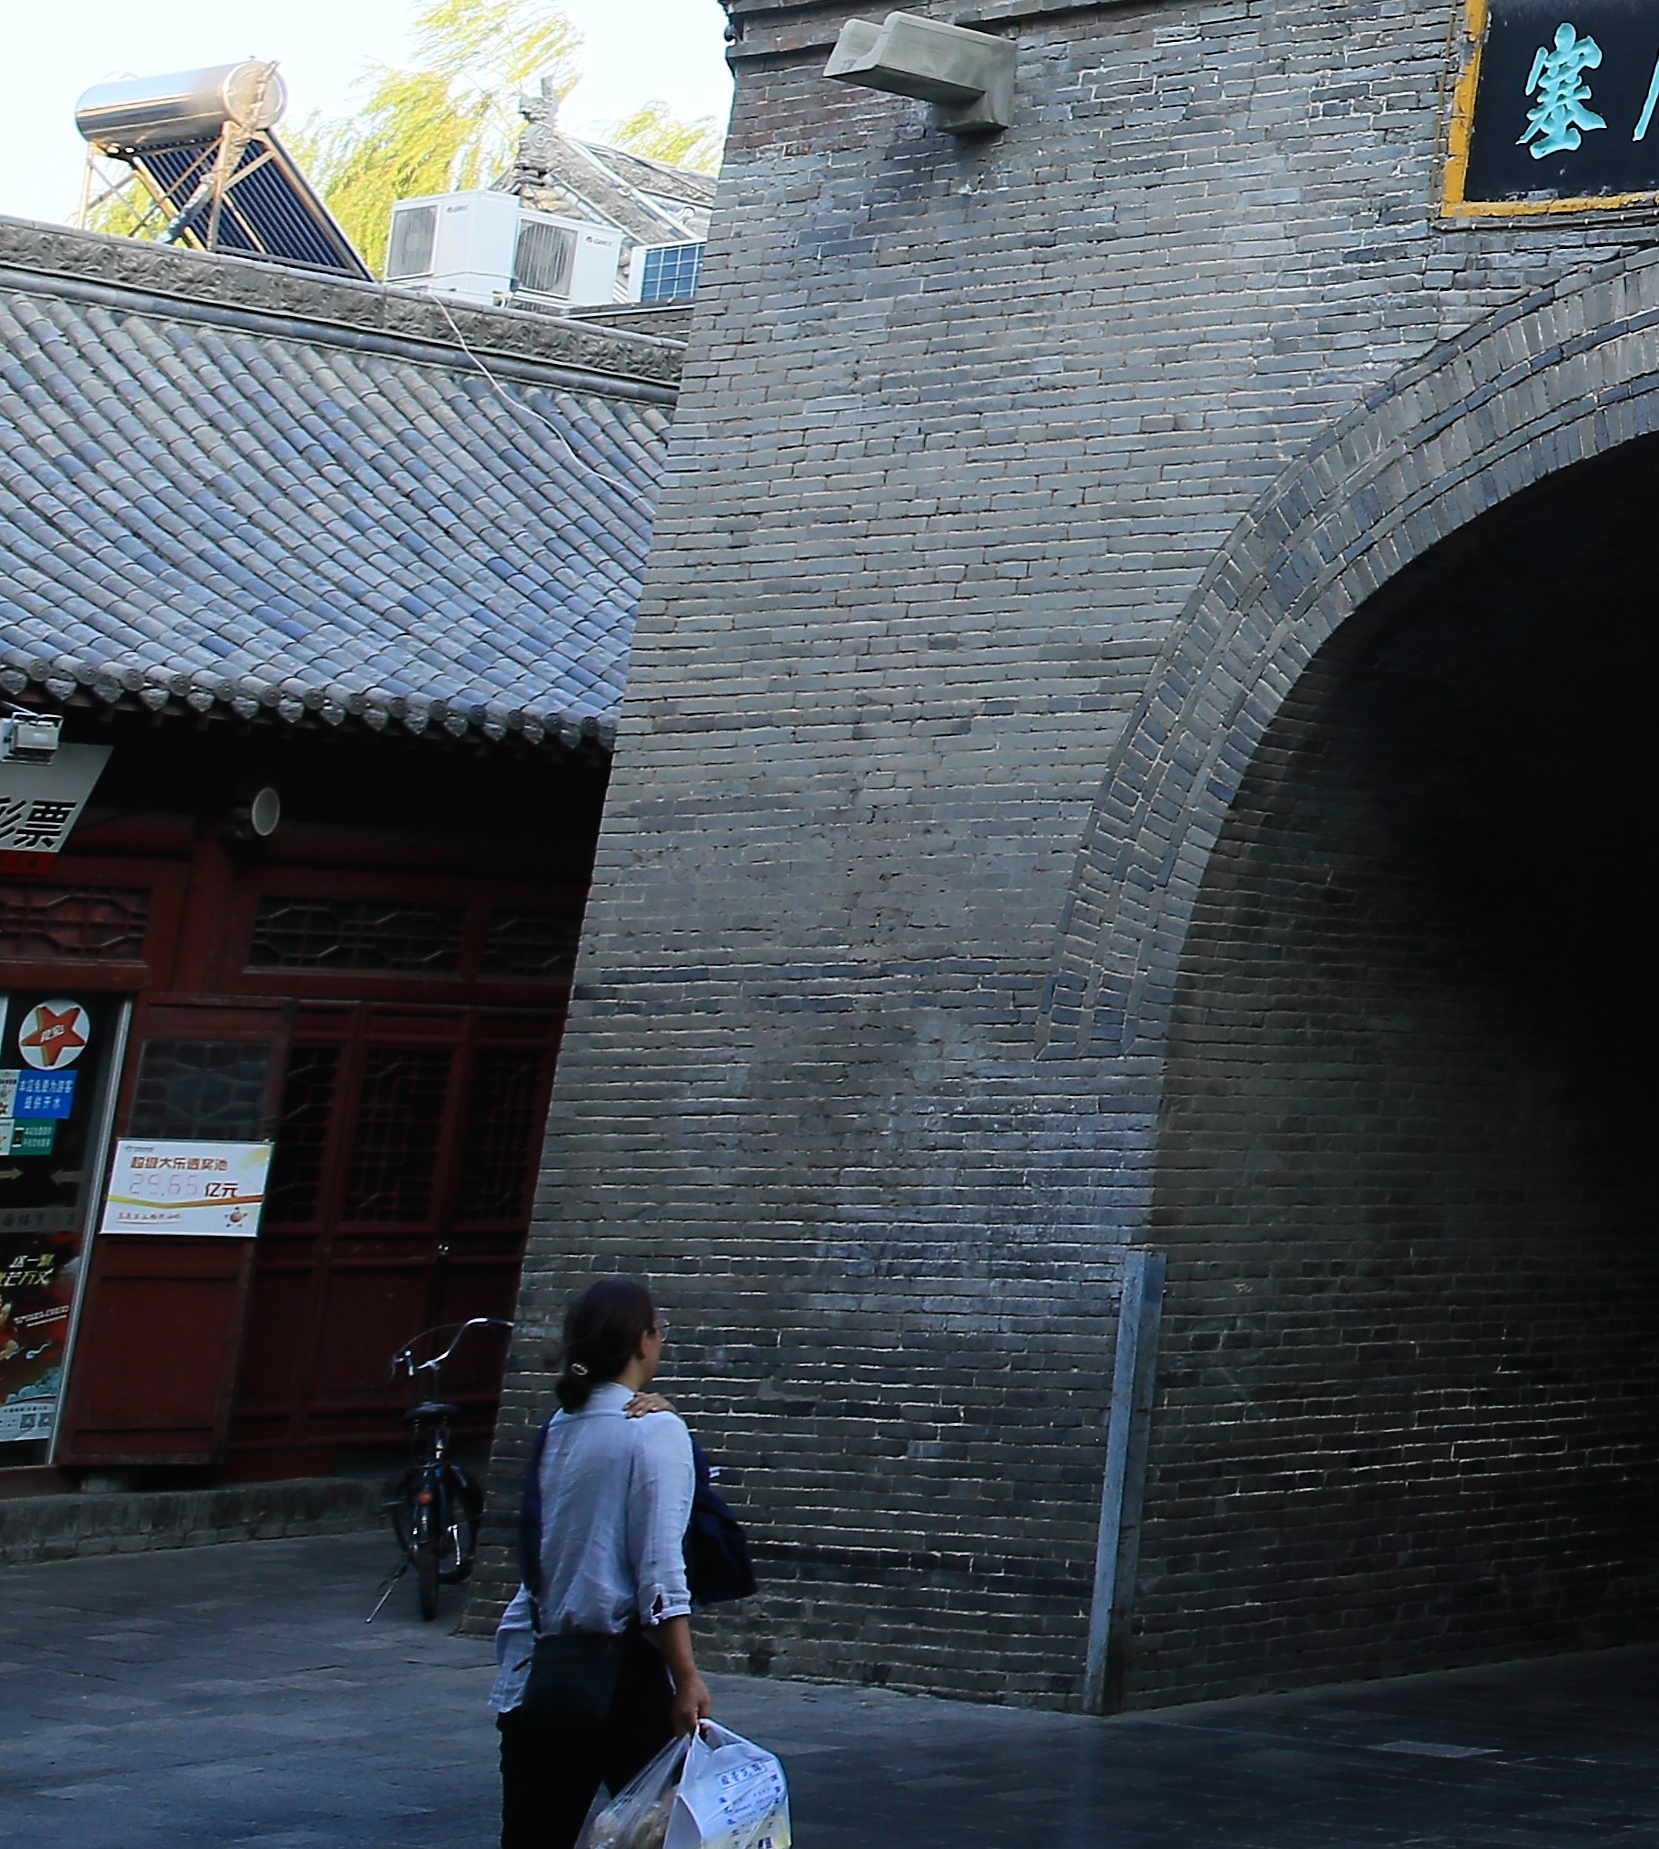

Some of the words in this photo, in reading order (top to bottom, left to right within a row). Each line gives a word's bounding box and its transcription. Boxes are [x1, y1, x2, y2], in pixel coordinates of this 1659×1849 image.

[130, 1156, 229, 1172] 超级大乐透奖池
[204, 1182, 239, 1198] 亿元
